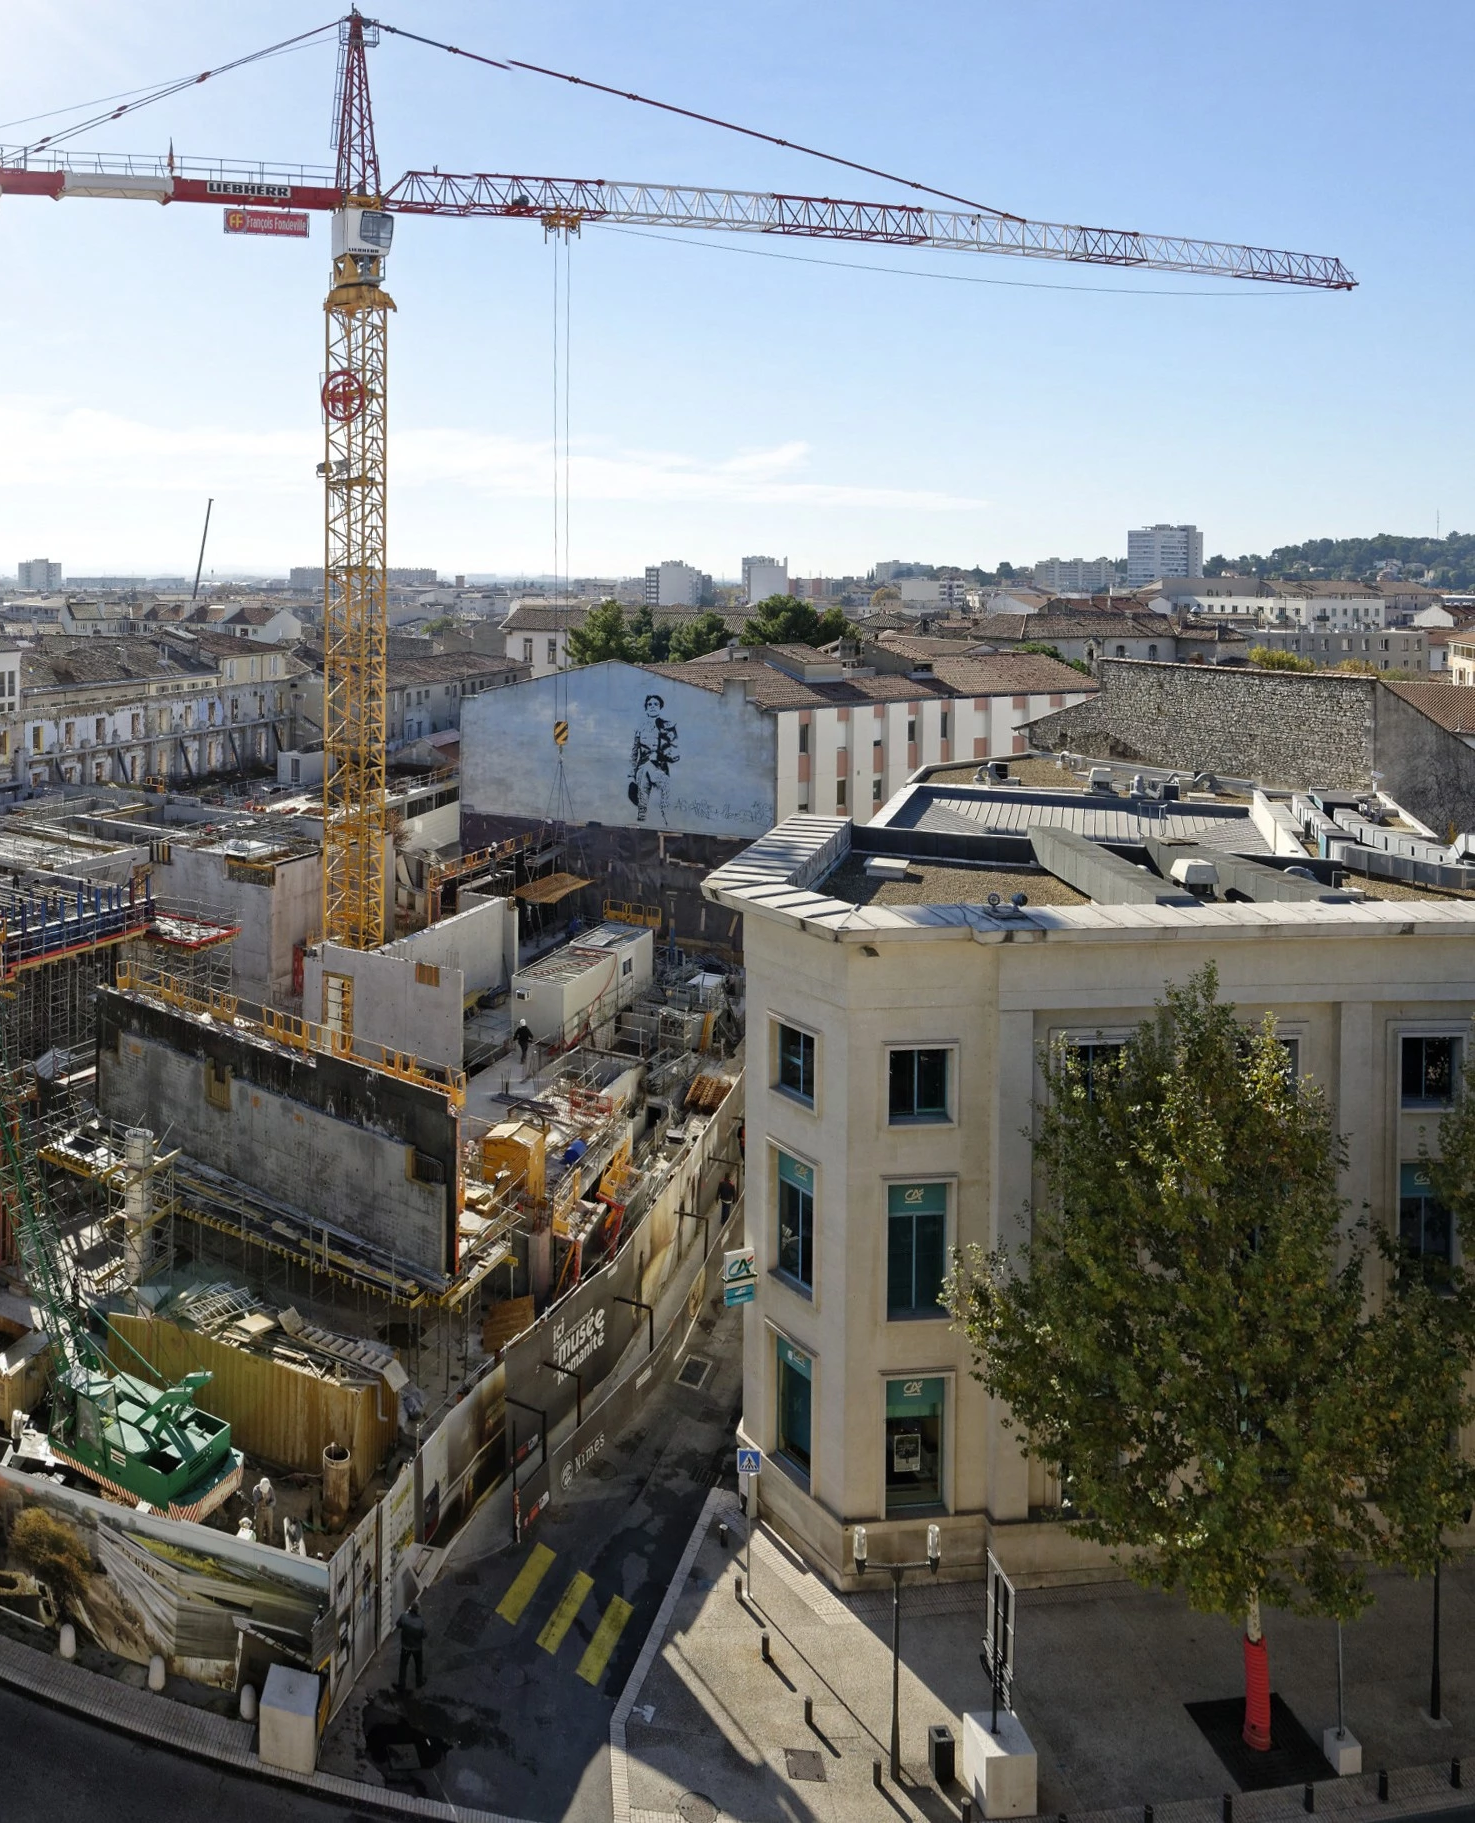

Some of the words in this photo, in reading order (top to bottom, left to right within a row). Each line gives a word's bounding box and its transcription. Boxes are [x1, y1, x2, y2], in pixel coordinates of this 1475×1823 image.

[209, 182, 288, 197] LIEBHERR
[229, 213, 244, 228] FF
[246, 215, 273, 231] François
[275, 217, 306, 232] Fondeville
[728, 1256, 754, 1277] CA
[553, 1317, 564, 1344] ici
[558, 1307, 605, 1367] musée
[557, 1327, 605, 1386] Romanité
